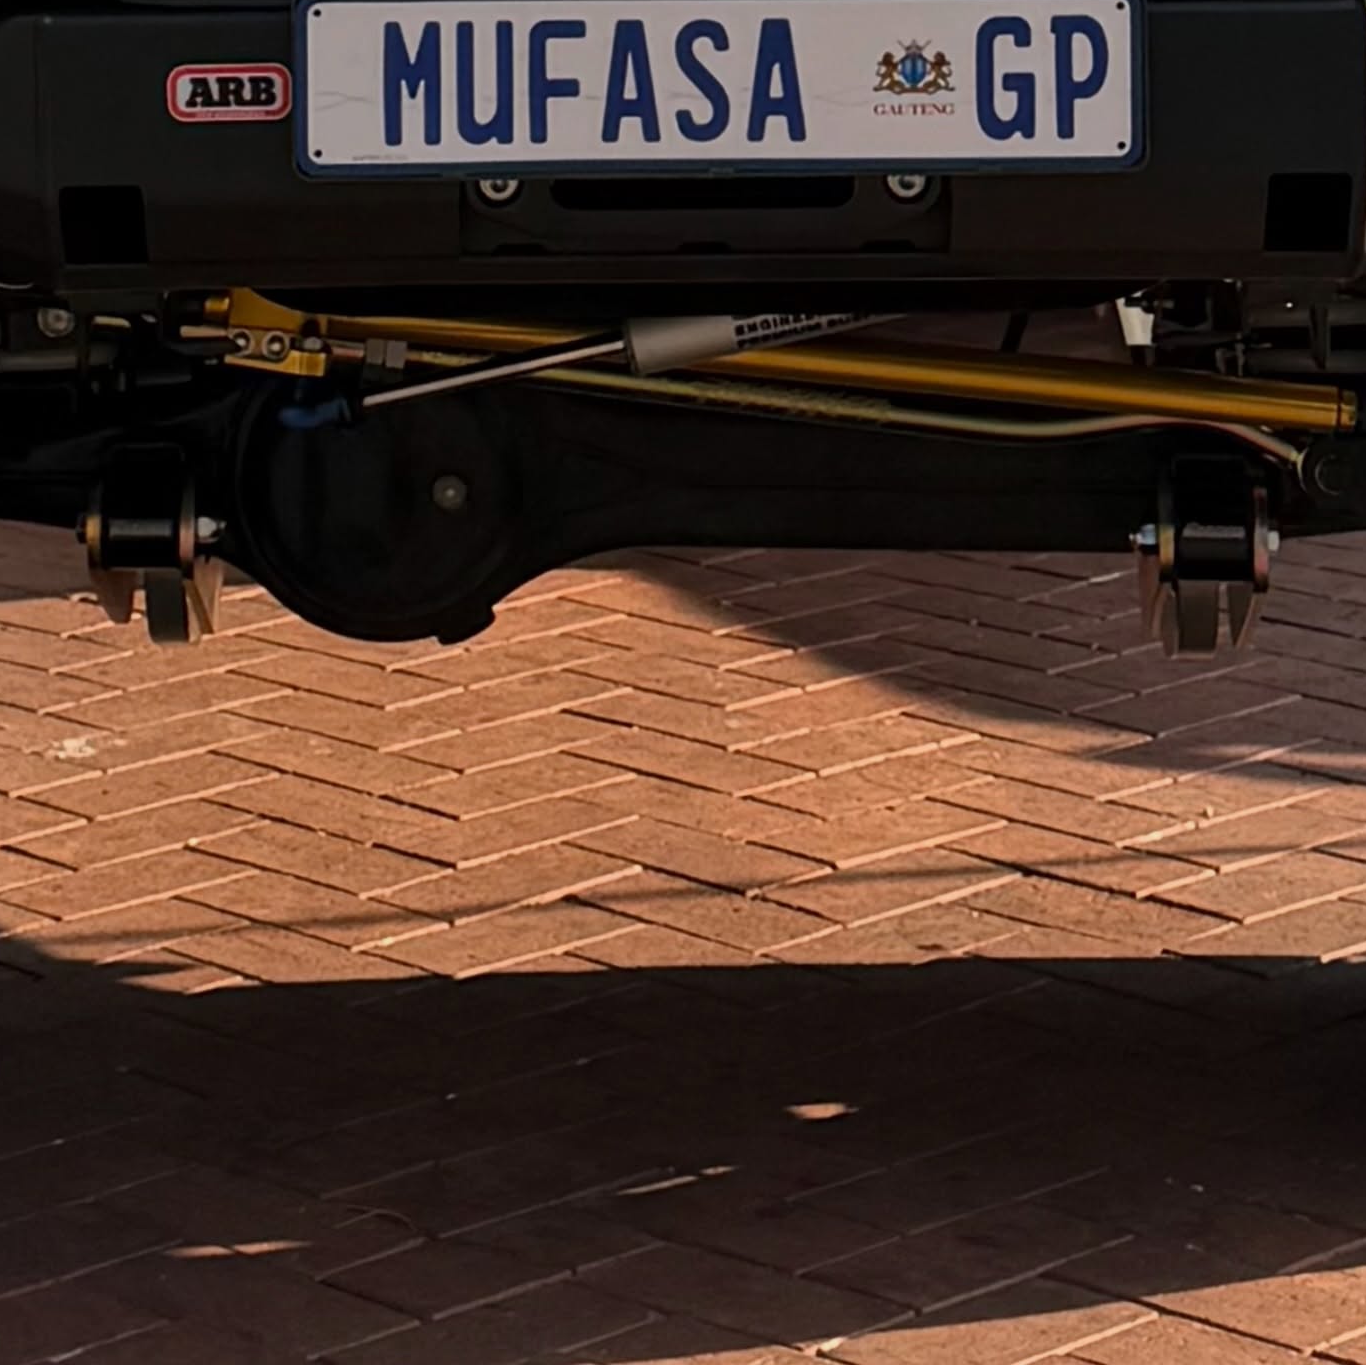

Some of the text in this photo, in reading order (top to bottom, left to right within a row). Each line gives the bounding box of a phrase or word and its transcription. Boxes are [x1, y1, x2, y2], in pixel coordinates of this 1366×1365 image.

[185, 75, 277, 109] ARB
[381, 13, 1110, 147] MUFASA GP
[872, 103, 956, 116] GAUTENG
